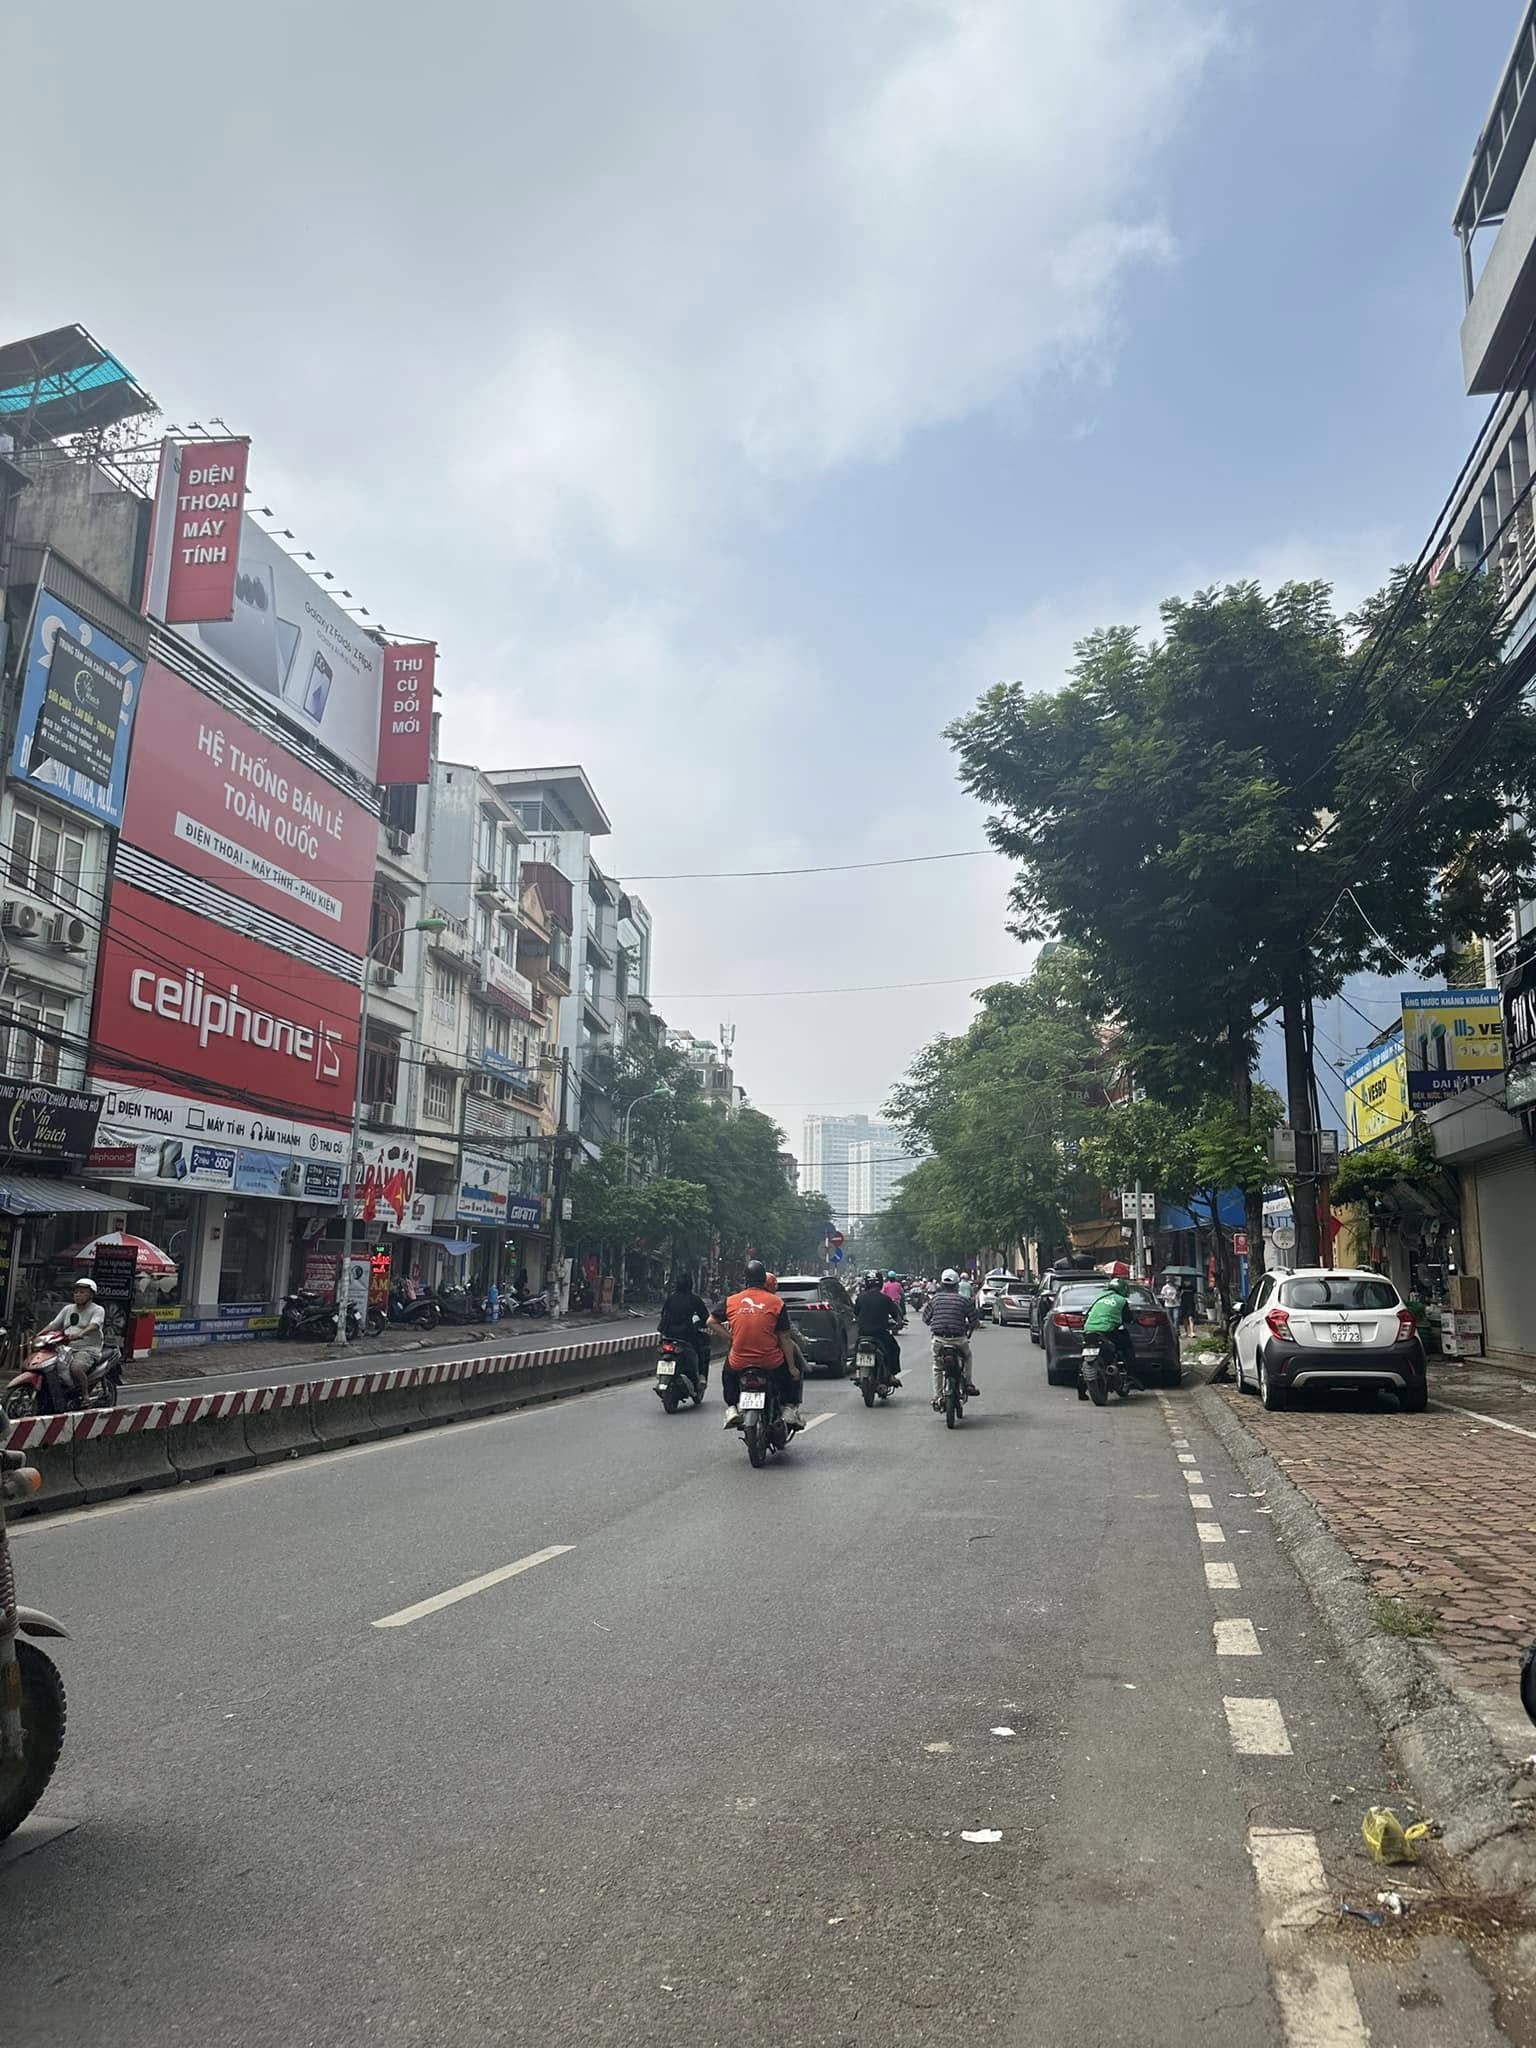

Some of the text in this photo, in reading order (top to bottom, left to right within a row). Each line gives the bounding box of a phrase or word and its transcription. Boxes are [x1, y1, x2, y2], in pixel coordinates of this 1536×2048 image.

[189, 464, 235, 486] ĐIỆN
[179, 493, 239, 512] THOẠI
[183, 518, 225, 538] MÁY
[182, 544, 227, 565] TÍNH
[393, 659, 423, 672] THU
[397, 676, 418, 692] CŨ
[393, 693, 420, 713] ĐỔI
[392, 716, 420, 734] MỚI
[198, 724, 344, 840] HỆ THỐNG BÁN LẺ
[223, 782, 319, 861] TOÀN QUỐC
[185, 822, 211, 847] ĐIỆN
[213, 837, 244, 866] THOẠI
[251, 859, 272, 879] MÁY
[272, 869, 294, 891] TÍNH
[300, 887, 318, 907] PHỤ
[318, 893, 337, 914] KIỆN
[144, 1105, 173, 1125] THOẠI
[207, 1116, 225, 1132] MÁY
[35, 1125, 67, 1142] Watch
[264, 1126, 276, 1142] ÂM
[320, 1140, 332, 1151] THU
